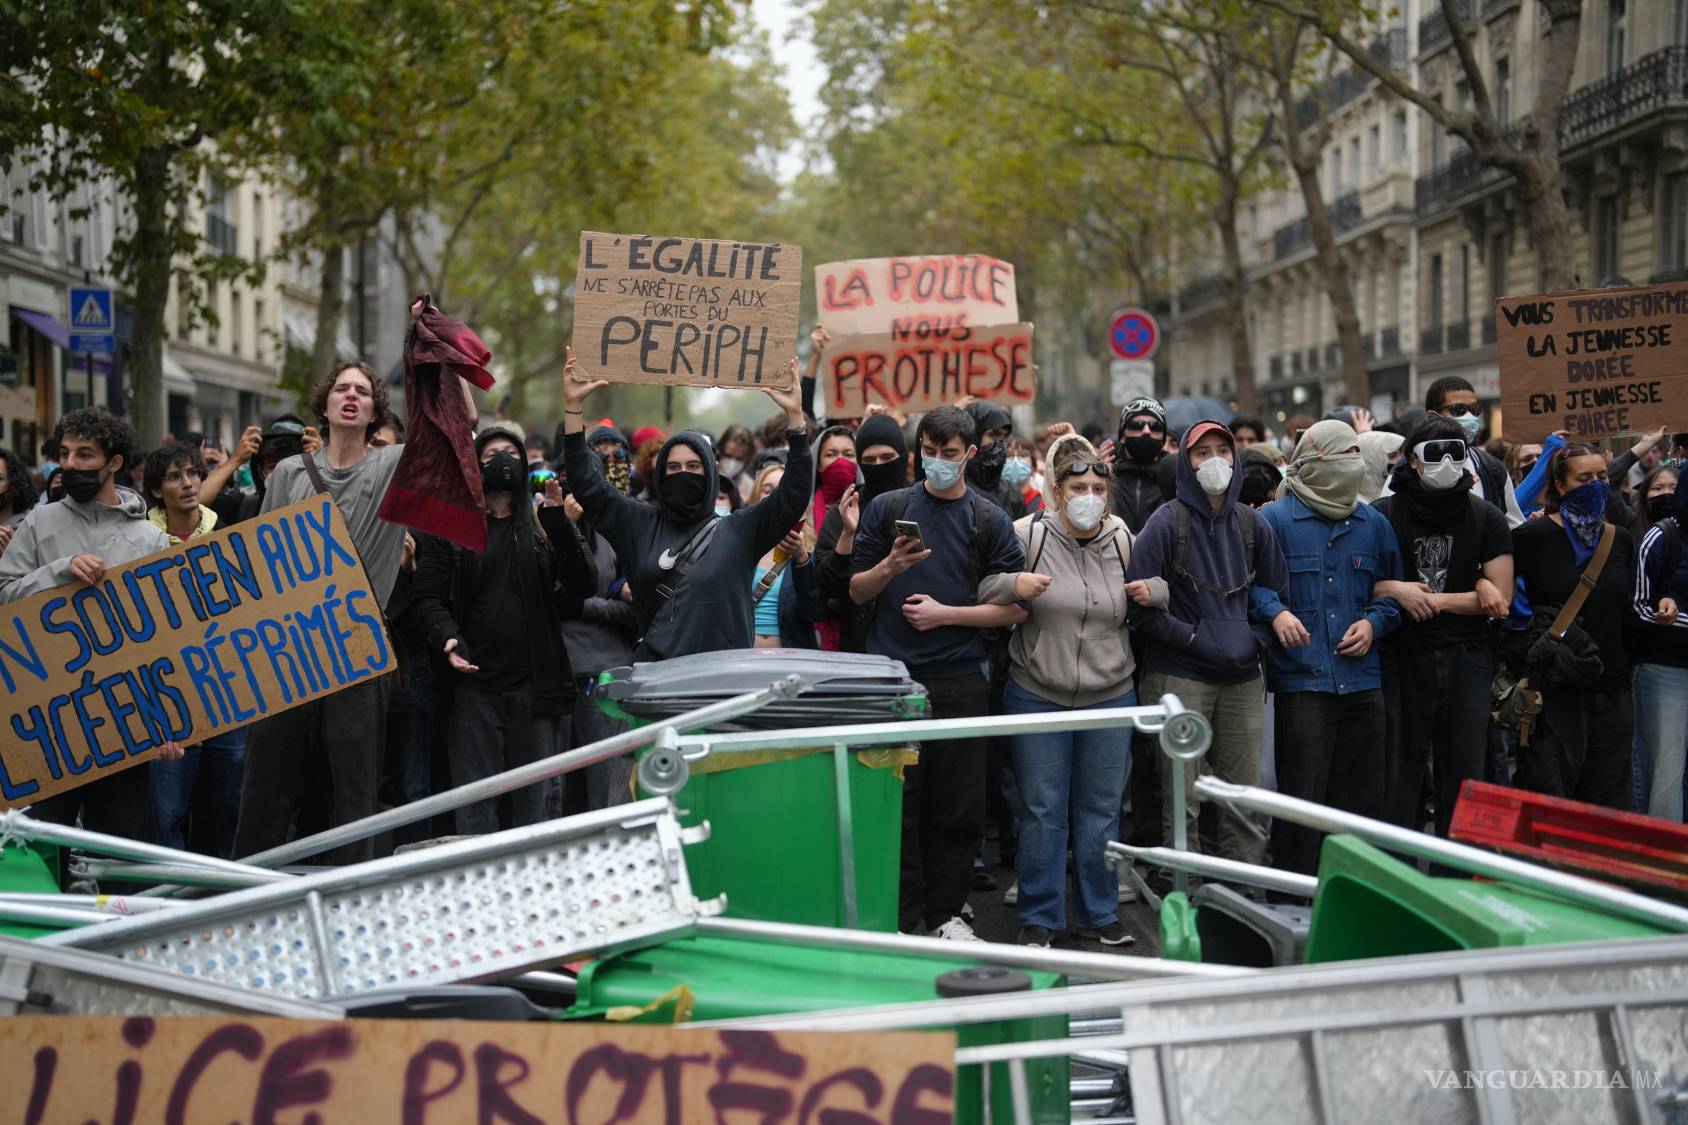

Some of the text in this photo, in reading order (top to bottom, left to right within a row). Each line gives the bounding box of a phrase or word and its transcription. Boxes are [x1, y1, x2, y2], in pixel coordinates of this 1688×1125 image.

[584, 277, 767, 307] NE S'ARRÊTE PAS AUX
[823, 256, 1011, 311] LA POLICE
[644, 301, 729, 321] PORTES DU
[1501, 302, 1555, 328] VOUS
[890, 313, 973, 342] NOUS
[1526, 324, 1672, 358] LA JEUNESSE
[831, 336, 1033, 408] PROTHESE
[1567, 352, 1635, 383] DORÉE
[1529, 381, 1663, 415] EN JEUNESSE
[257, 501, 356, 595] AUX
